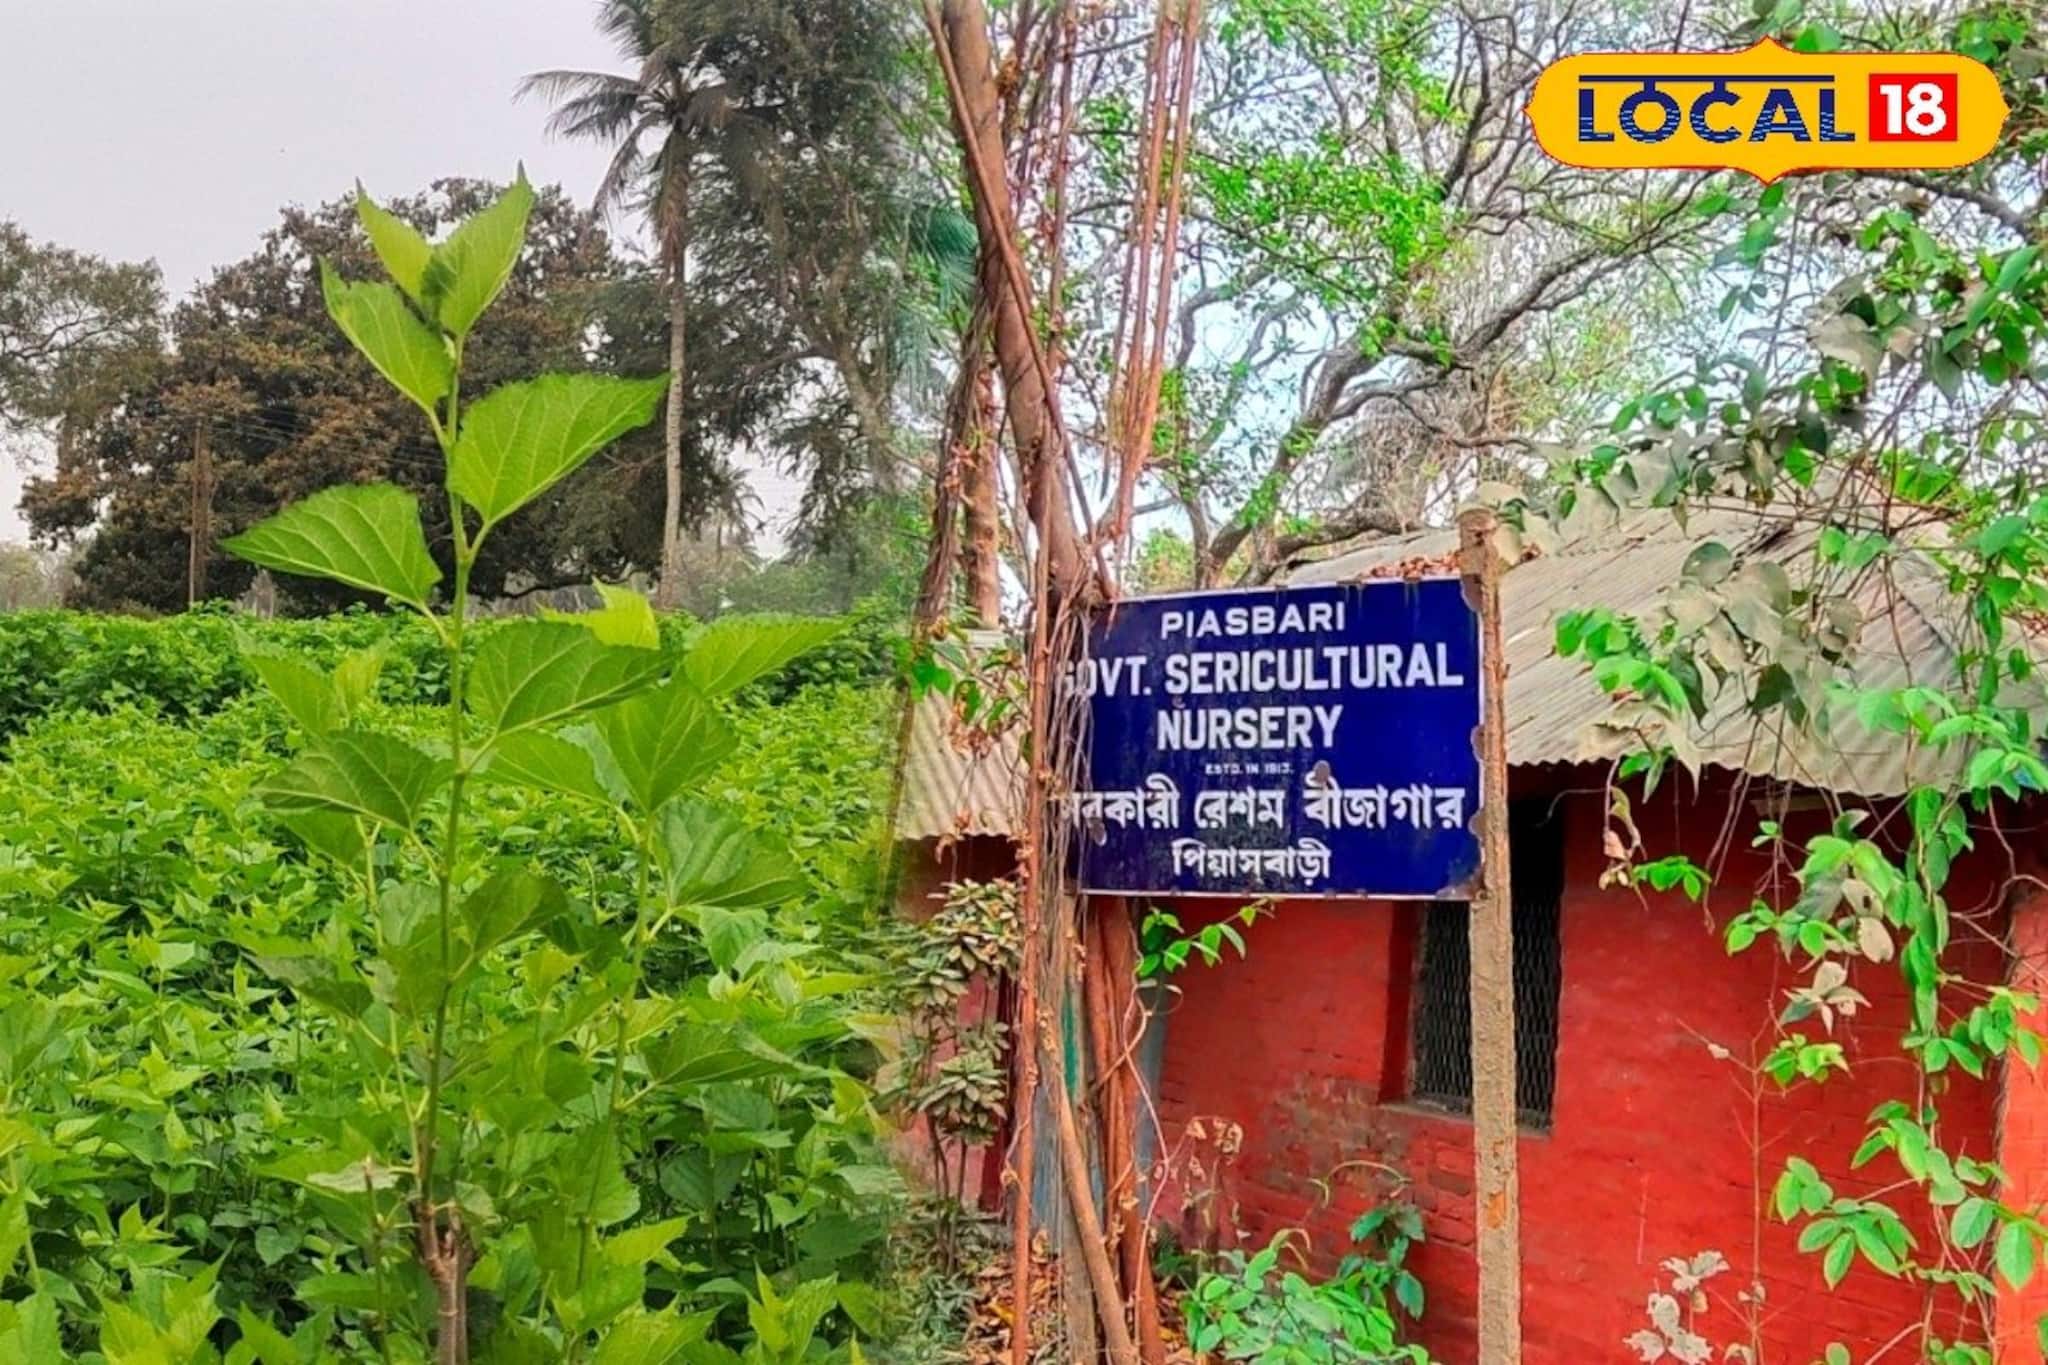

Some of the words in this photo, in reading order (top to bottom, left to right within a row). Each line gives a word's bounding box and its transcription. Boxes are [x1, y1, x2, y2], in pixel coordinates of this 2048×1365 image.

[1161, 603, 1345, 639] PIASBARI
[1165, 643, 1464, 695] SERICULTURAL
[1157, 705, 1343, 751] NURSERY
[1205, 763, 1243, 774] ESTD.
[1246, 763, 1259, 774] IN
[1194, 786, 1285, 829] রেশম
[1302, 766, 1466, 829] বীজাগার
